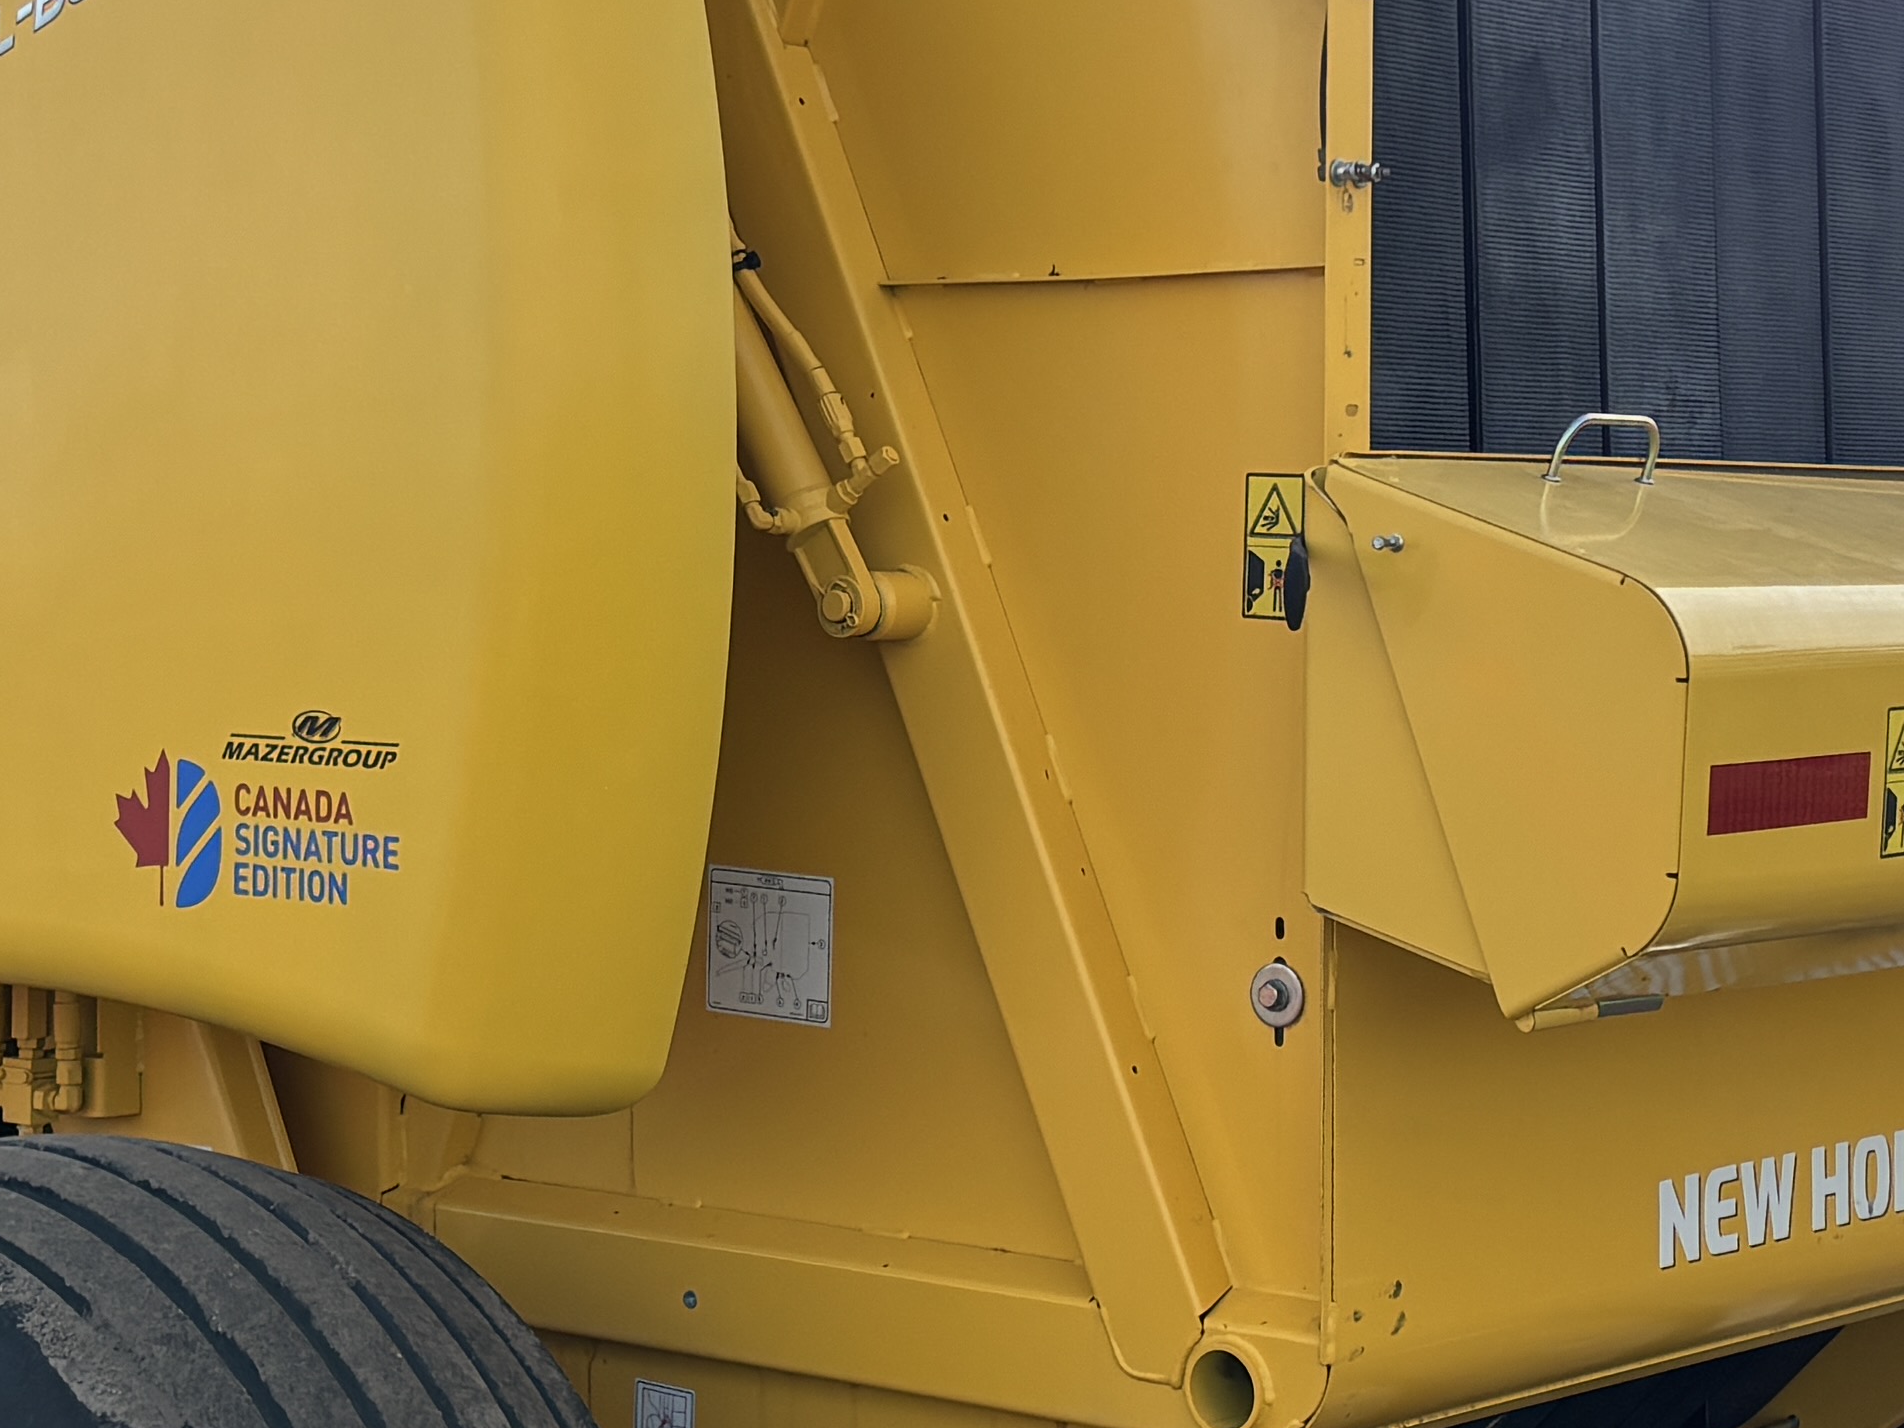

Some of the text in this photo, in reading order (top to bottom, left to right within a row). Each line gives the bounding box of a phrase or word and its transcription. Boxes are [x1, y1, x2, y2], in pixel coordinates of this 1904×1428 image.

[222, 741, 399, 770] MAZERGROUP
[233, 782, 354, 826] CANADA
[233, 822, 401, 871] SIGNATURE
[232, 861, 349, 906] EDITION
[1657, 1151, 1797, 1270] NEW
